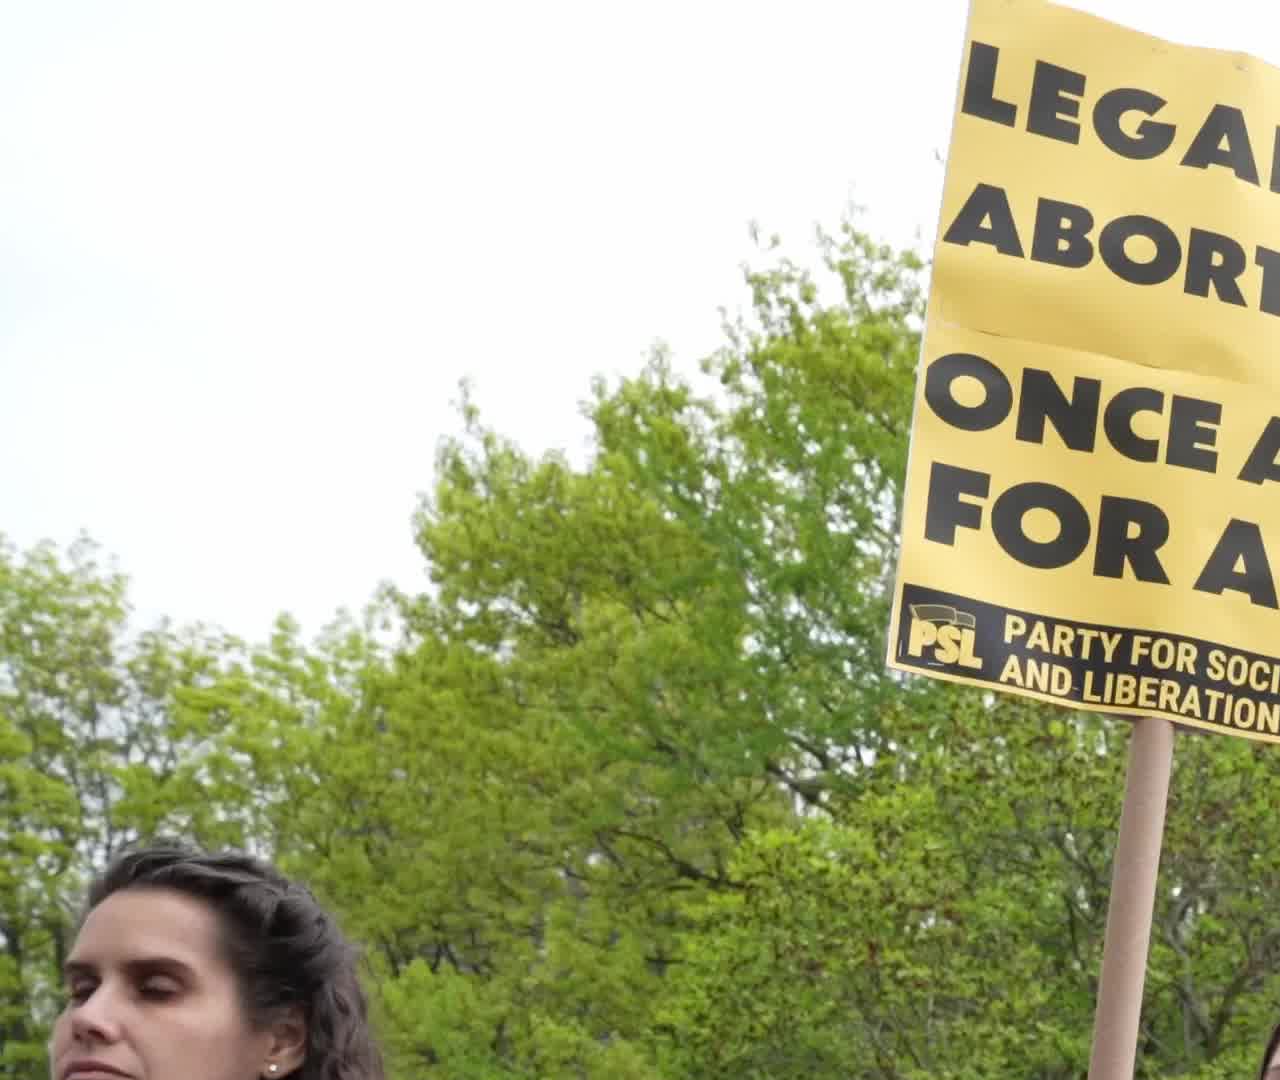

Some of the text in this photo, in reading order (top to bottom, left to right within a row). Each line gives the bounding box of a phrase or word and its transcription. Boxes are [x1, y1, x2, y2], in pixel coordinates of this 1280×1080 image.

[925, 352, 1223, 473] ONCE
[925, 462, 1170, 585] FOR
[907, 618, 983, 670] PSL
[1004, 613, 1122, 663] PARTY
[1130, 634, 1198, 675] FOR
[1000, 654, 1280, 733] AND LIBERATION
